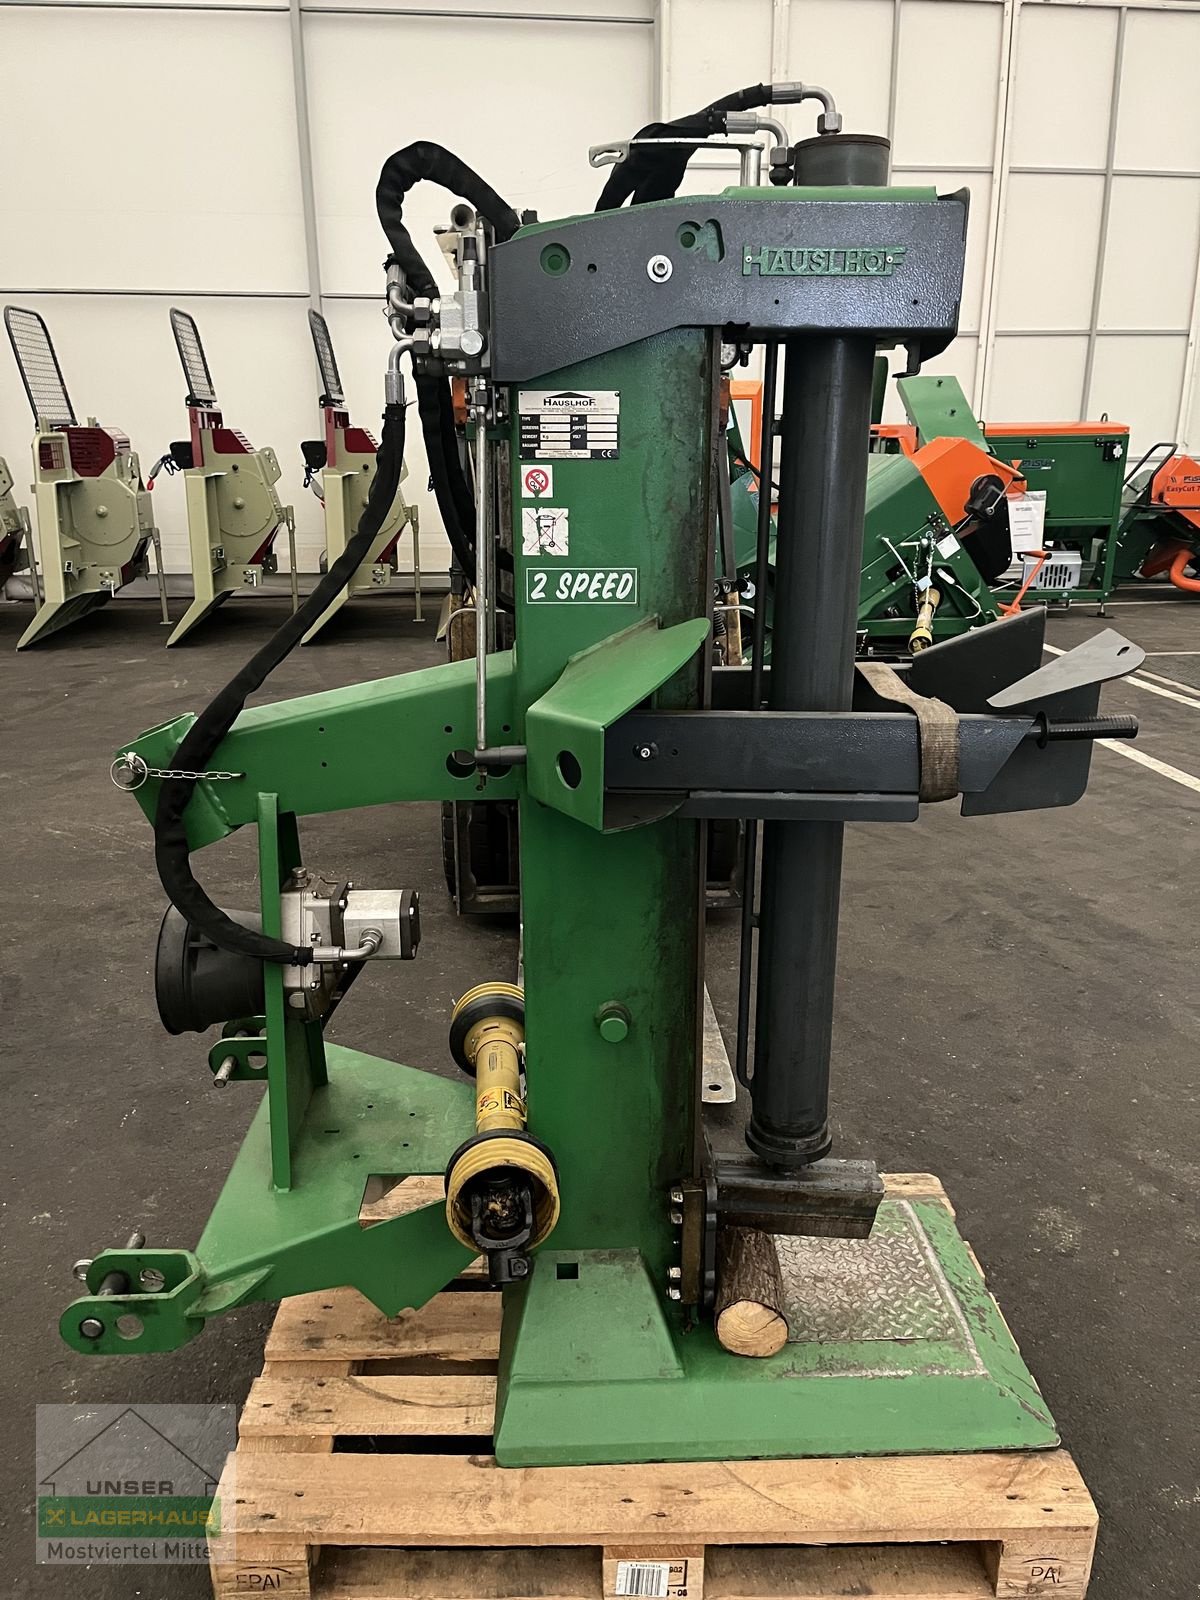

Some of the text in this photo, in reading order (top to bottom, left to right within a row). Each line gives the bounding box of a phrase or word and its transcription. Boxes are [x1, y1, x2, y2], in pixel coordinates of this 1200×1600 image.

[742, 246, 907, 276] HAUSLHOF
[543, 398, 596, 407] HAUSLHOF
[530, 572, 634, 600] 2 SPEED
